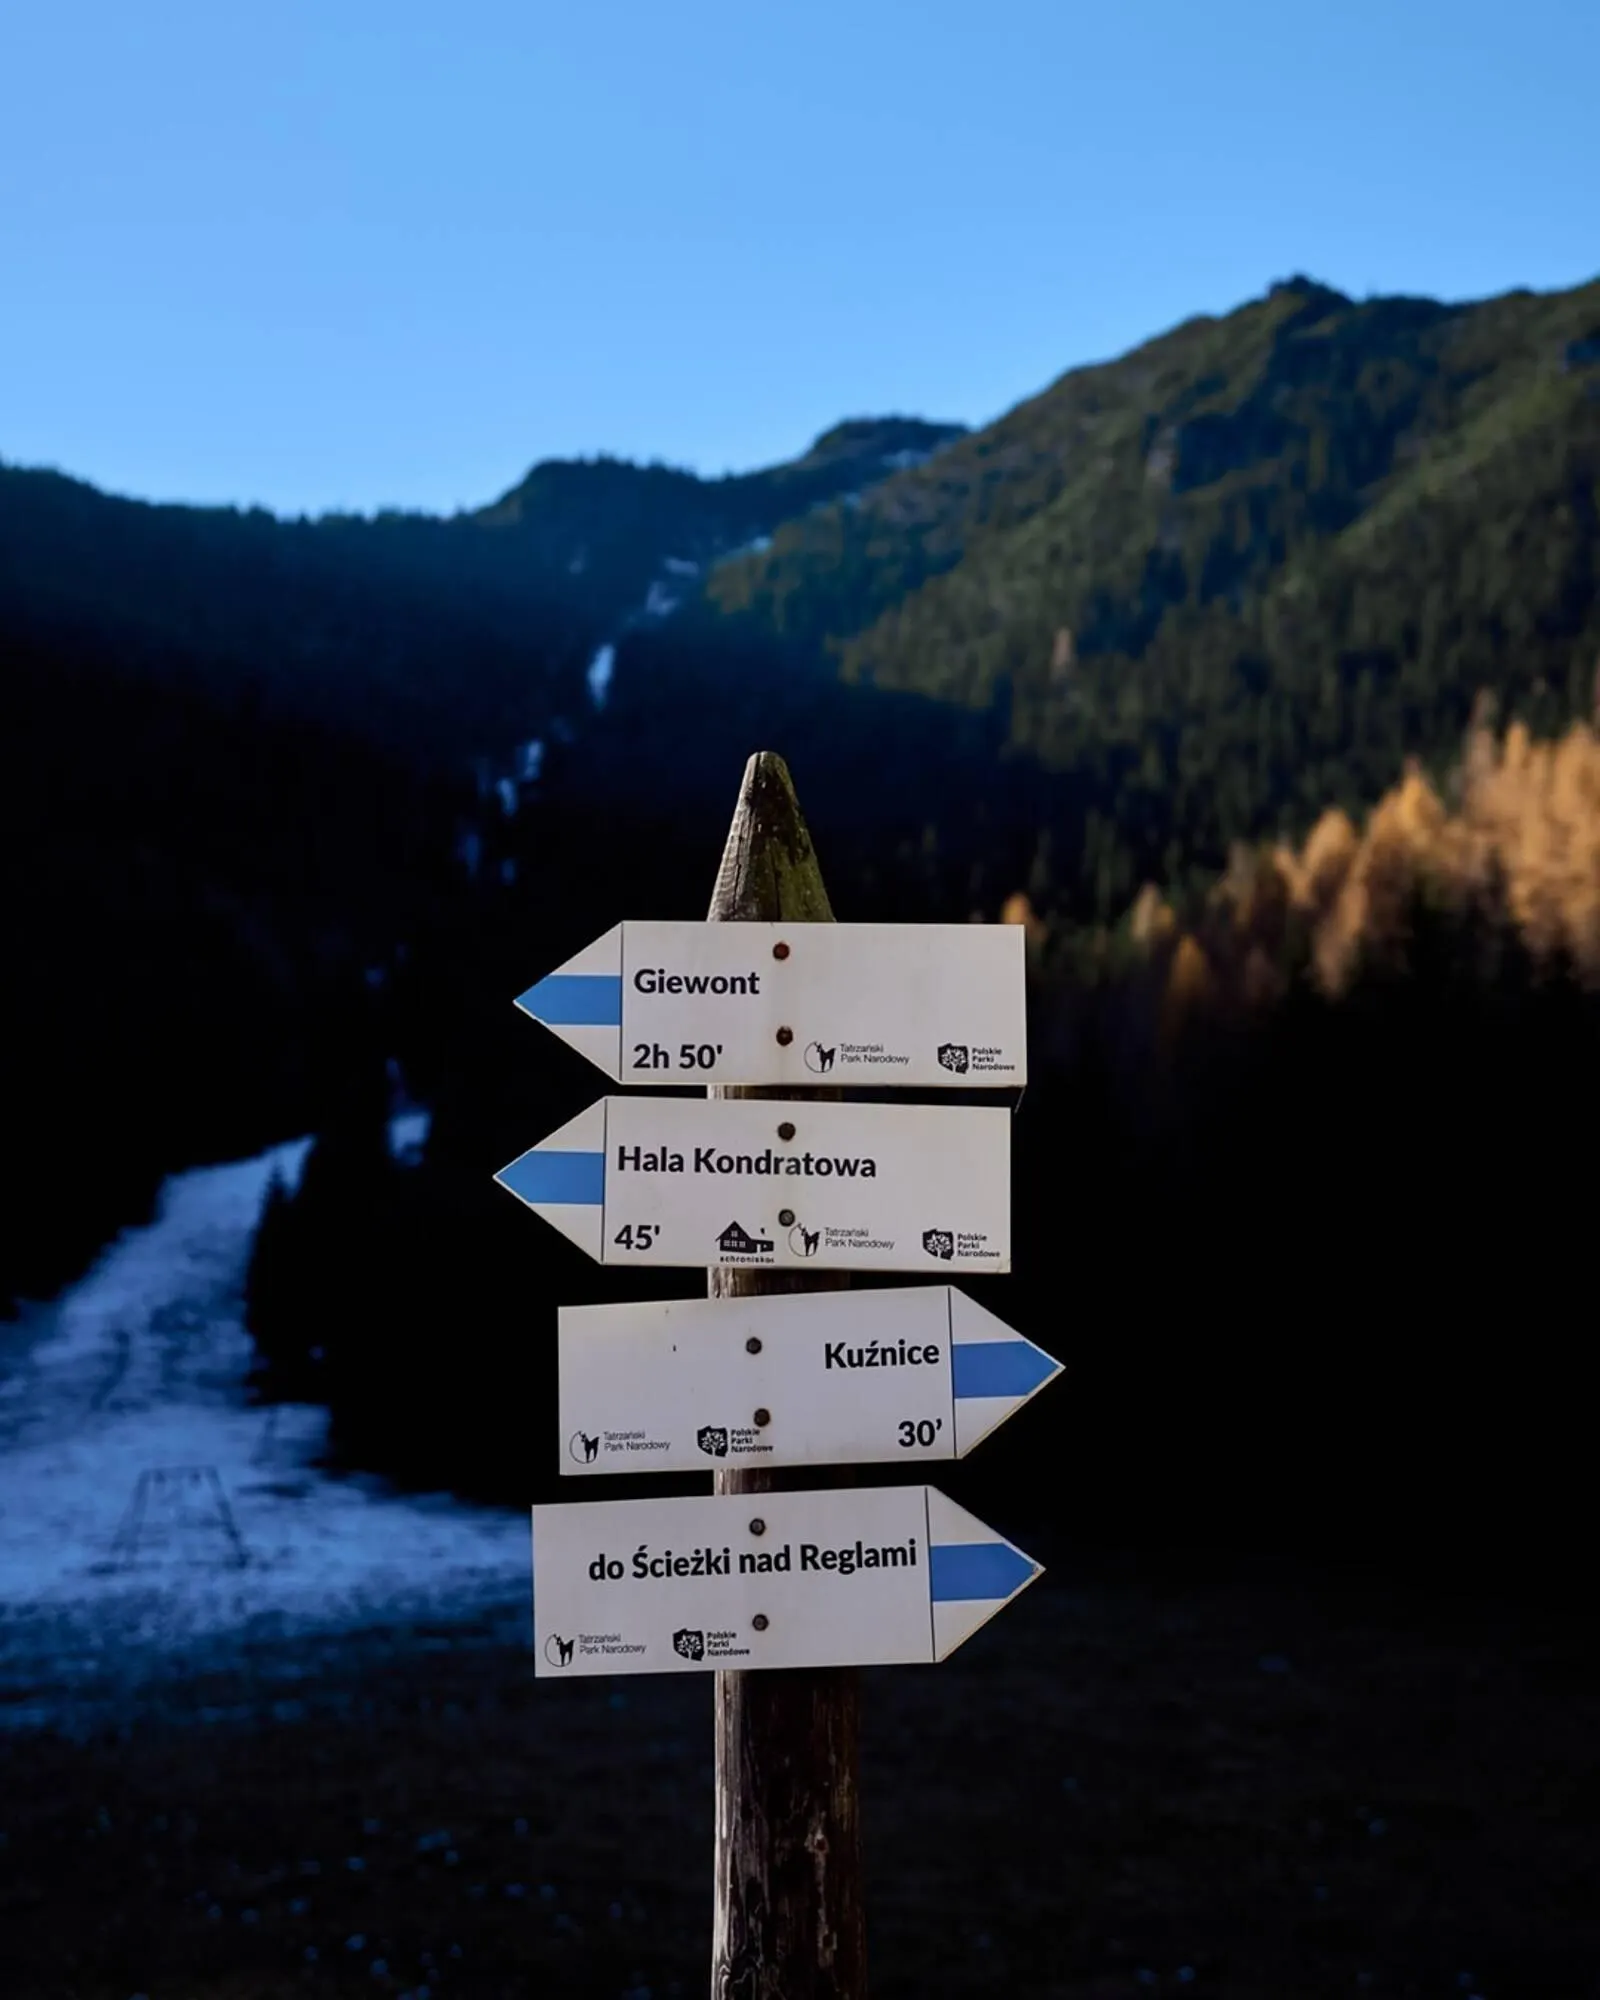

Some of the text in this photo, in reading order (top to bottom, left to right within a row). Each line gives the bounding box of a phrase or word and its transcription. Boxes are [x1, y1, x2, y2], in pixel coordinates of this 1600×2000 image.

[633, 967, 761, 995] Giewont
[632, 1042, 723, 1070] 2h 50'
[972, 1047, 1002, 1056] Polskie
[840, 1053, 910, 1065] Park Narodowy
[972, 1063, 1015, 1071] Narodowe
[617, 1145, 877, 1178] Hala Kondratowa
[613, 1224, 661, 1251] 45'
[957, 1233, 987, 1241] Polskie
[824, 1237, 895, 1250] Park Narodowy
[957, 1241, 979, 1249] Parki
[957, 1249, 1000, 1257] Narodowe
[824, 1338, 940, 1370] Kuźnice
[730, 1428, 760, 1437] Polskie
[898, 1418, 943, 1448] 30’
[604, 1440, 671, 1451] Park Narodowy
[730, 1437, 753, 1445] Parki
[730, 1444, 774, 1453] Narodowe
[588, 1538, 917, 1582] do Ścieżki nad Reglami
[707, 1631, 736, 1639] Polskie
[707, 1639, 729, 1648] Parki
[579, 1644, 647, 1654] Park Narodowy
[707, 1648, 750, 1656] Narodowe
